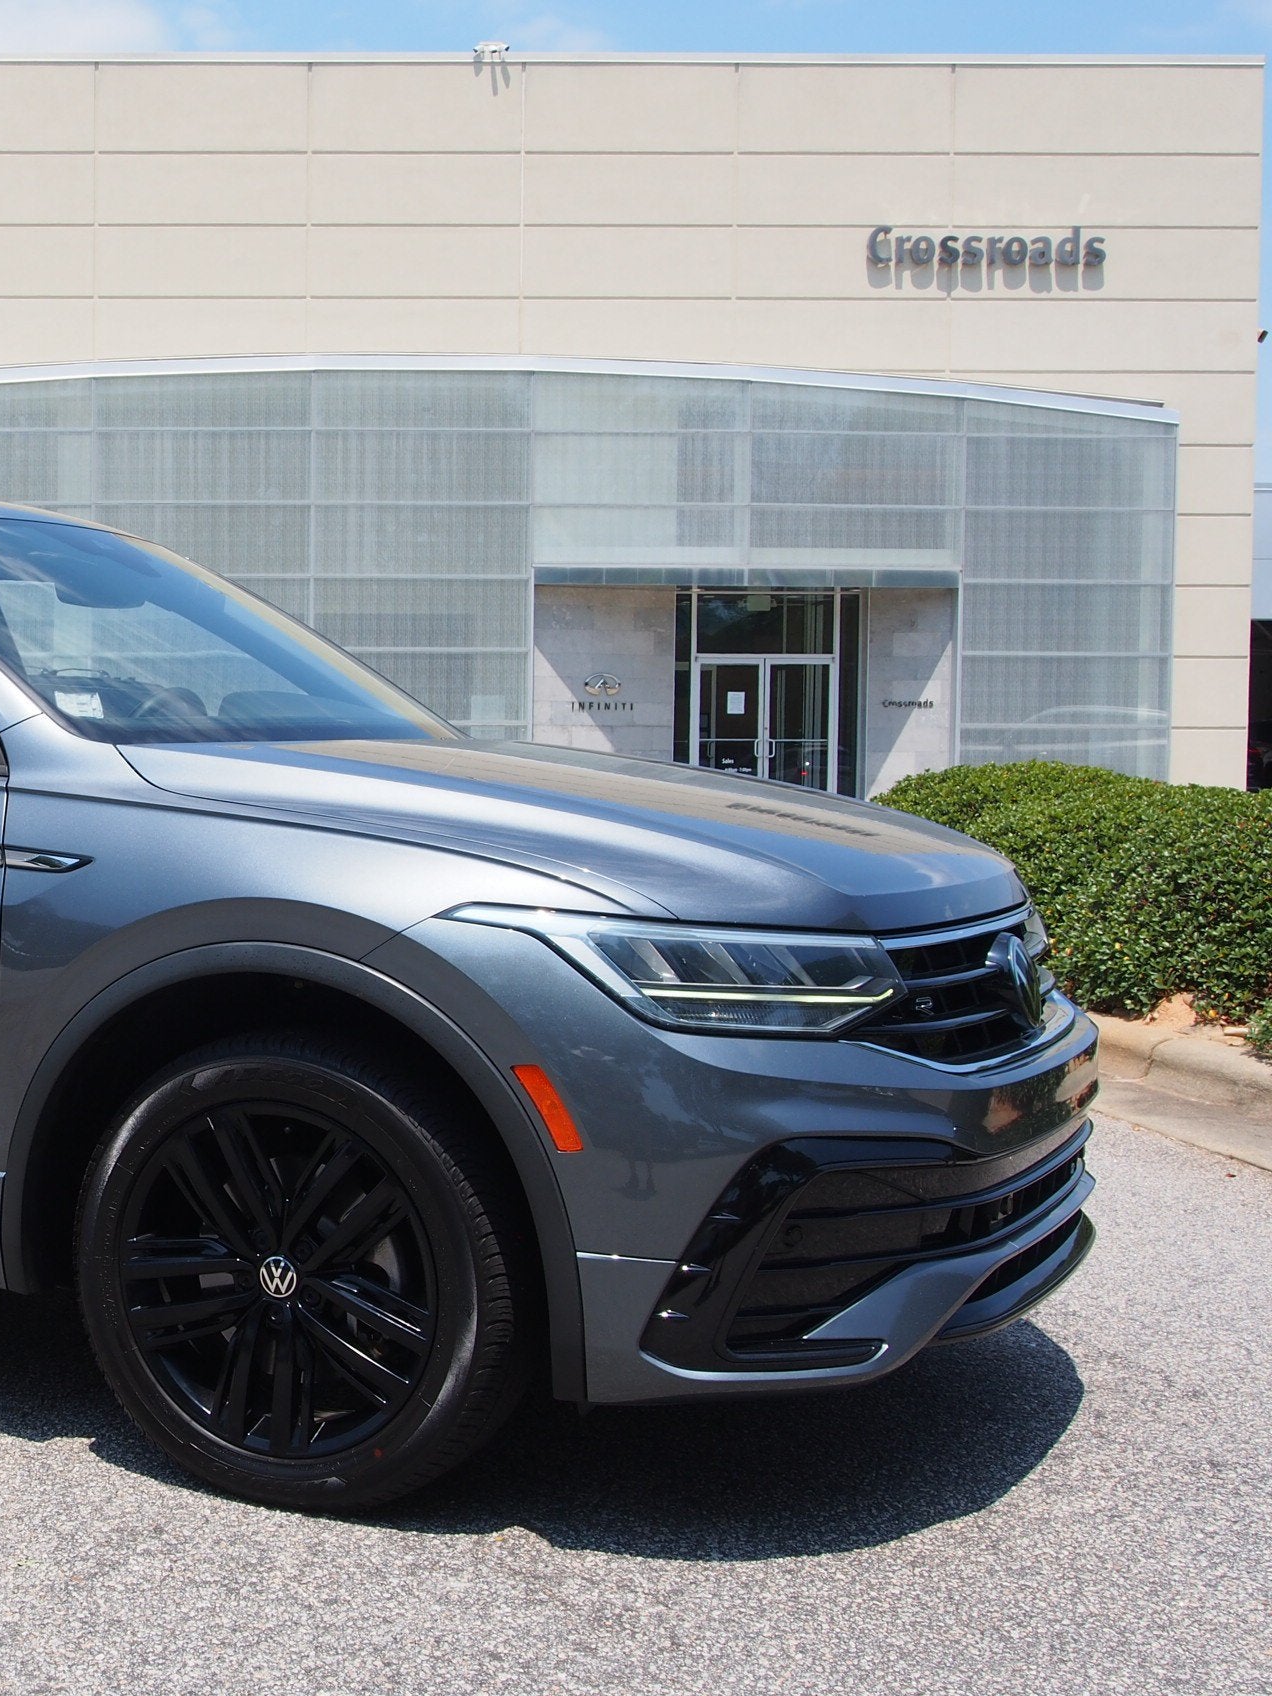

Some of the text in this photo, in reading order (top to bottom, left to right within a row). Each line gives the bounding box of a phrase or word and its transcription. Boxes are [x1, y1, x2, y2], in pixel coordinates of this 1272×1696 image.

[866, 225, 1107, 266] Crossroads
[571, 702, 634, 711] INFINITI
[915, 996, 934, 1015] R
[260, 1256, 296, 1297] VW
